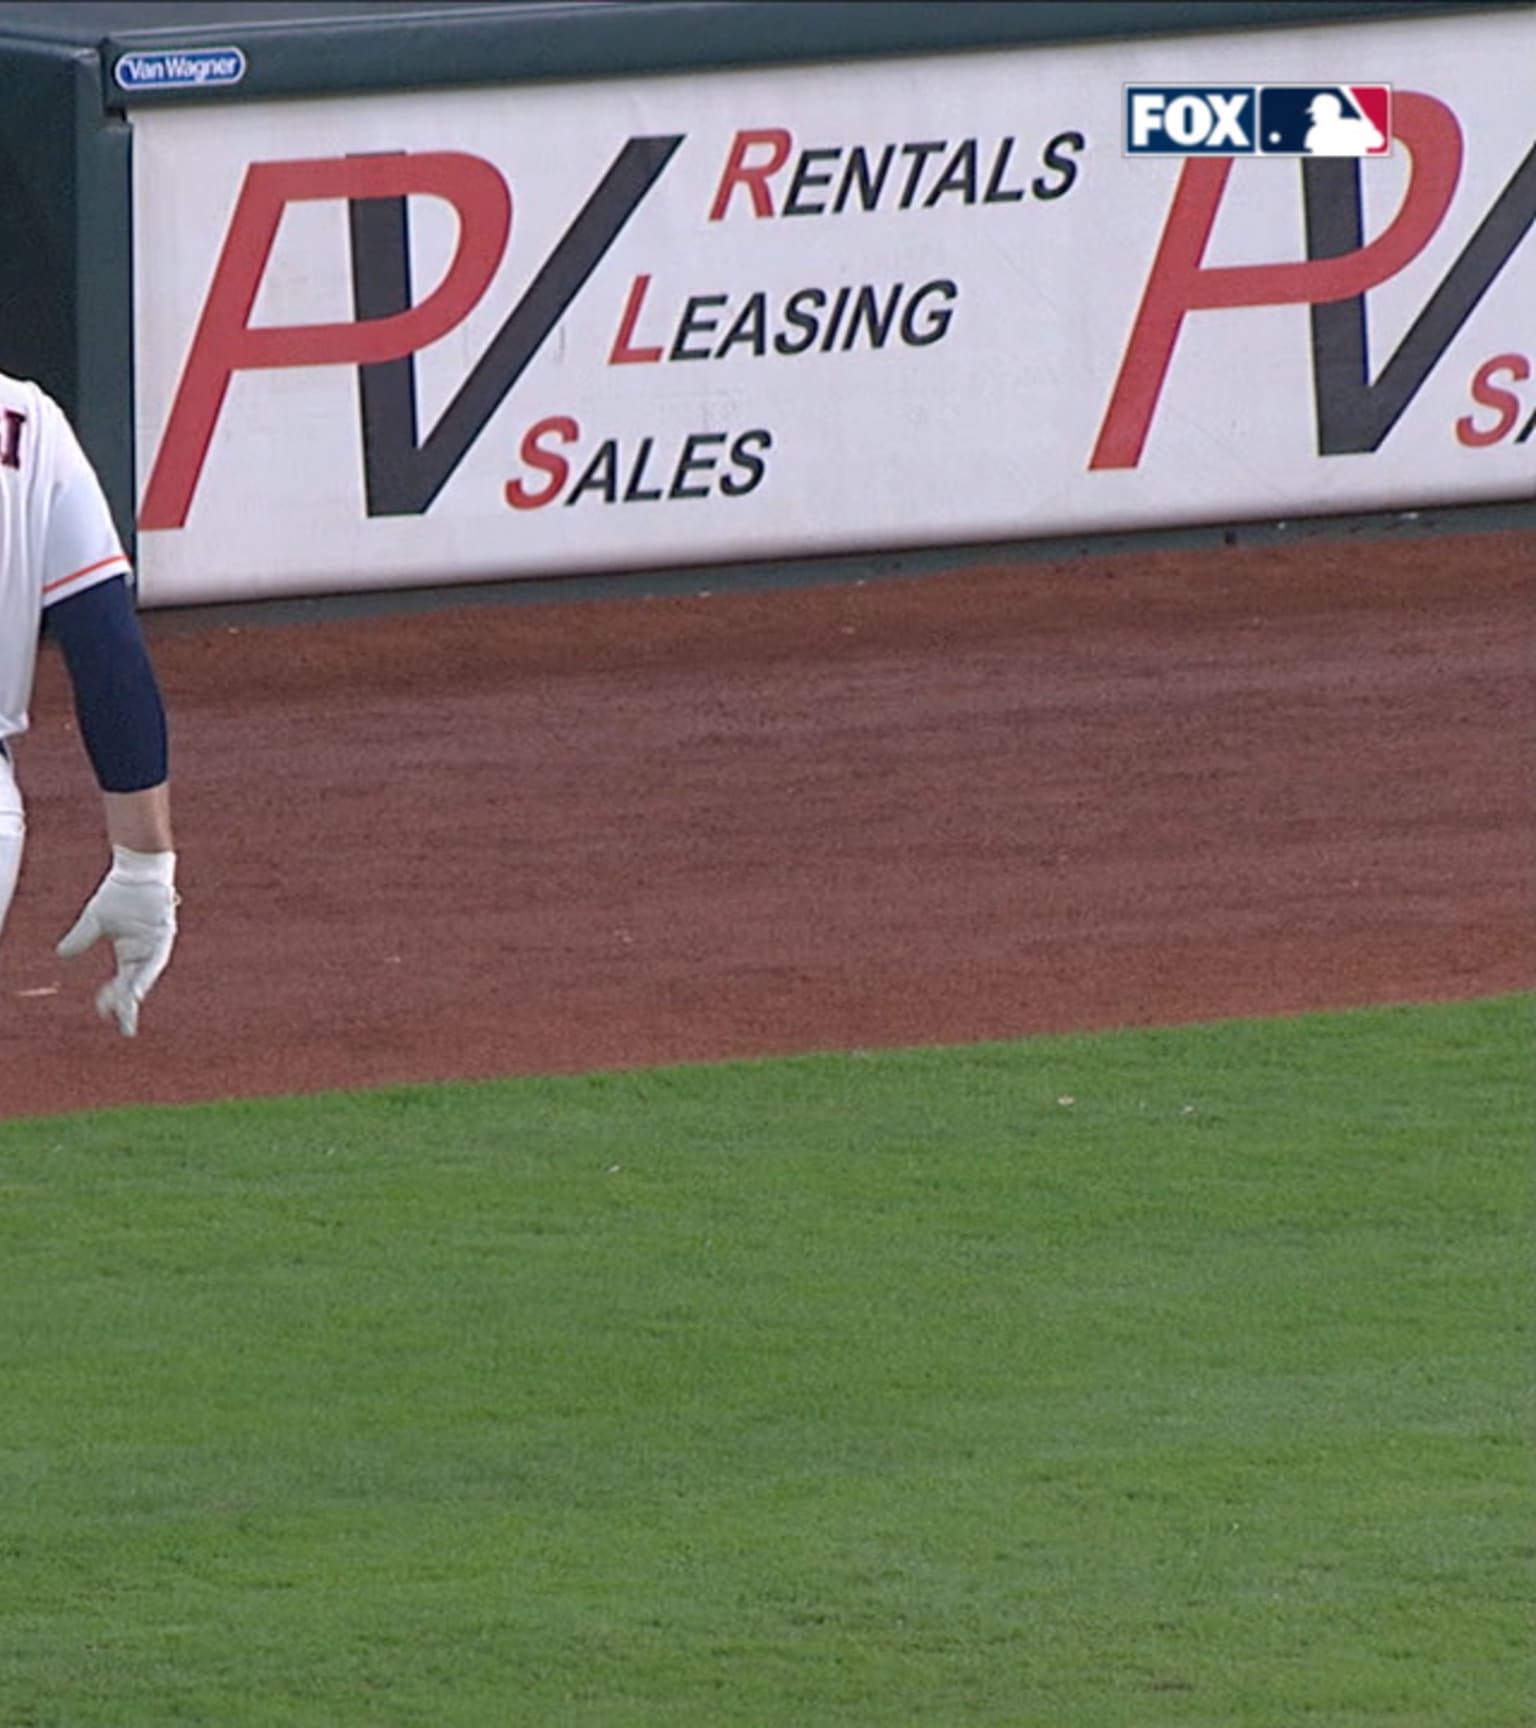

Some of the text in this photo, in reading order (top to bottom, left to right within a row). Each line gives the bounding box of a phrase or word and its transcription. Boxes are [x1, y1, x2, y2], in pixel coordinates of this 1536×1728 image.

[127, 55, 238, 83] Van Wagner
[709, 129, 1083, 221] RENTALS
[137, 134, 684, 531] PV
[609, 275, 956, 366] LEASING
[505, 416, 771, 511] SALES
